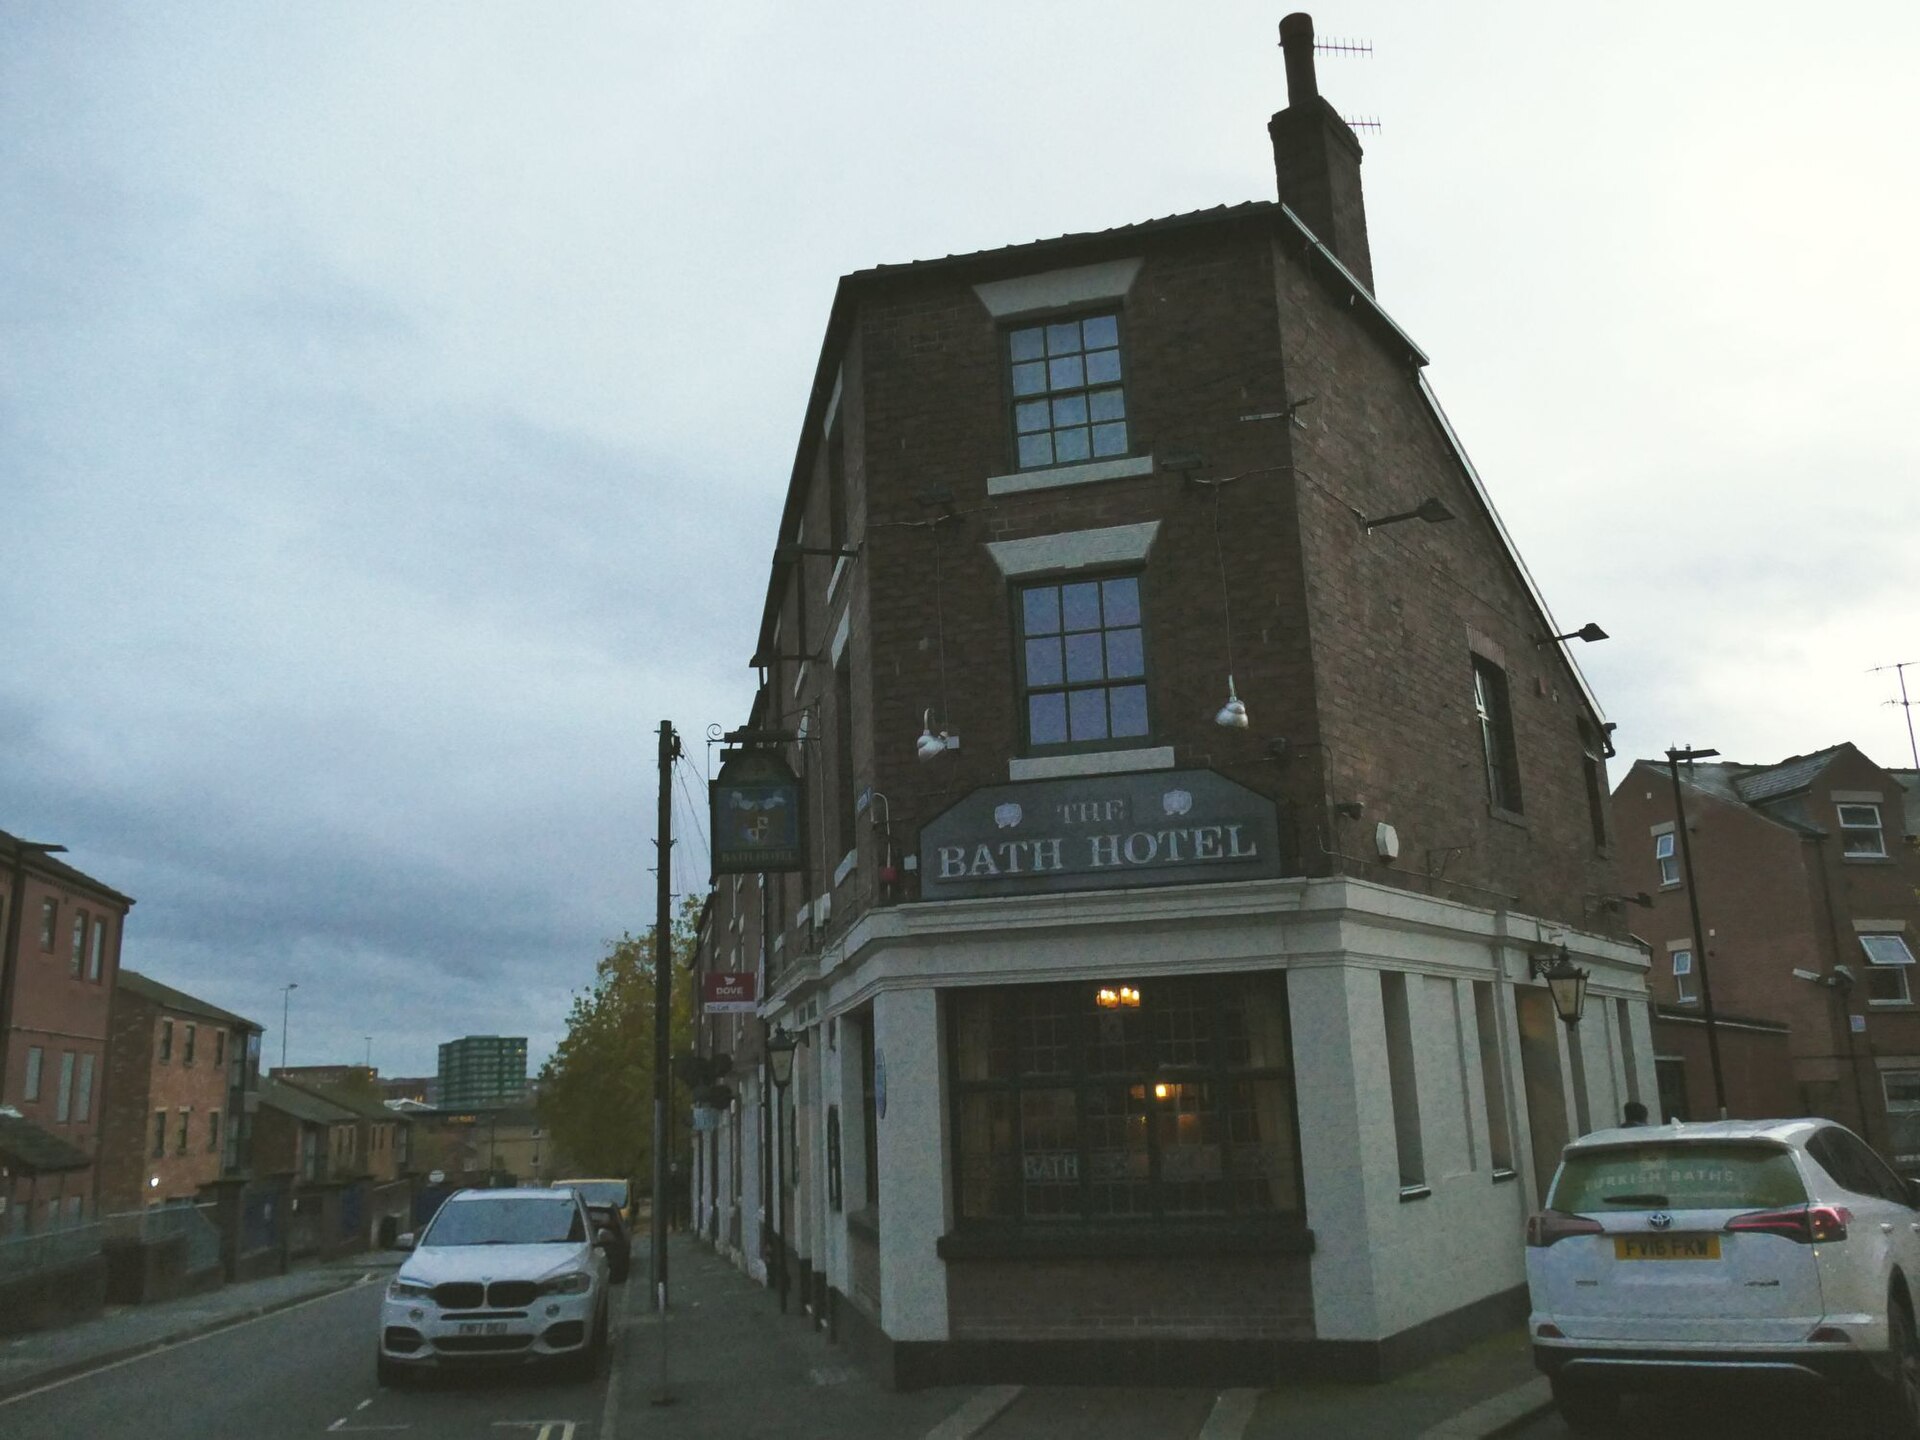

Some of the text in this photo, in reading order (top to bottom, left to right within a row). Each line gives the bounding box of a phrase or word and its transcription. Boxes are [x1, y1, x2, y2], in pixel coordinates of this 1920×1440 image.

[1056, 799, 1124, 824] THE
[937, 824, 1257, 879] BATH HOTEL
[716, 986, 744, 996] DOVE
[1023, 1154, 1079, 1179] BATH
[1671, 1169, 1734, 1184] BATHS
